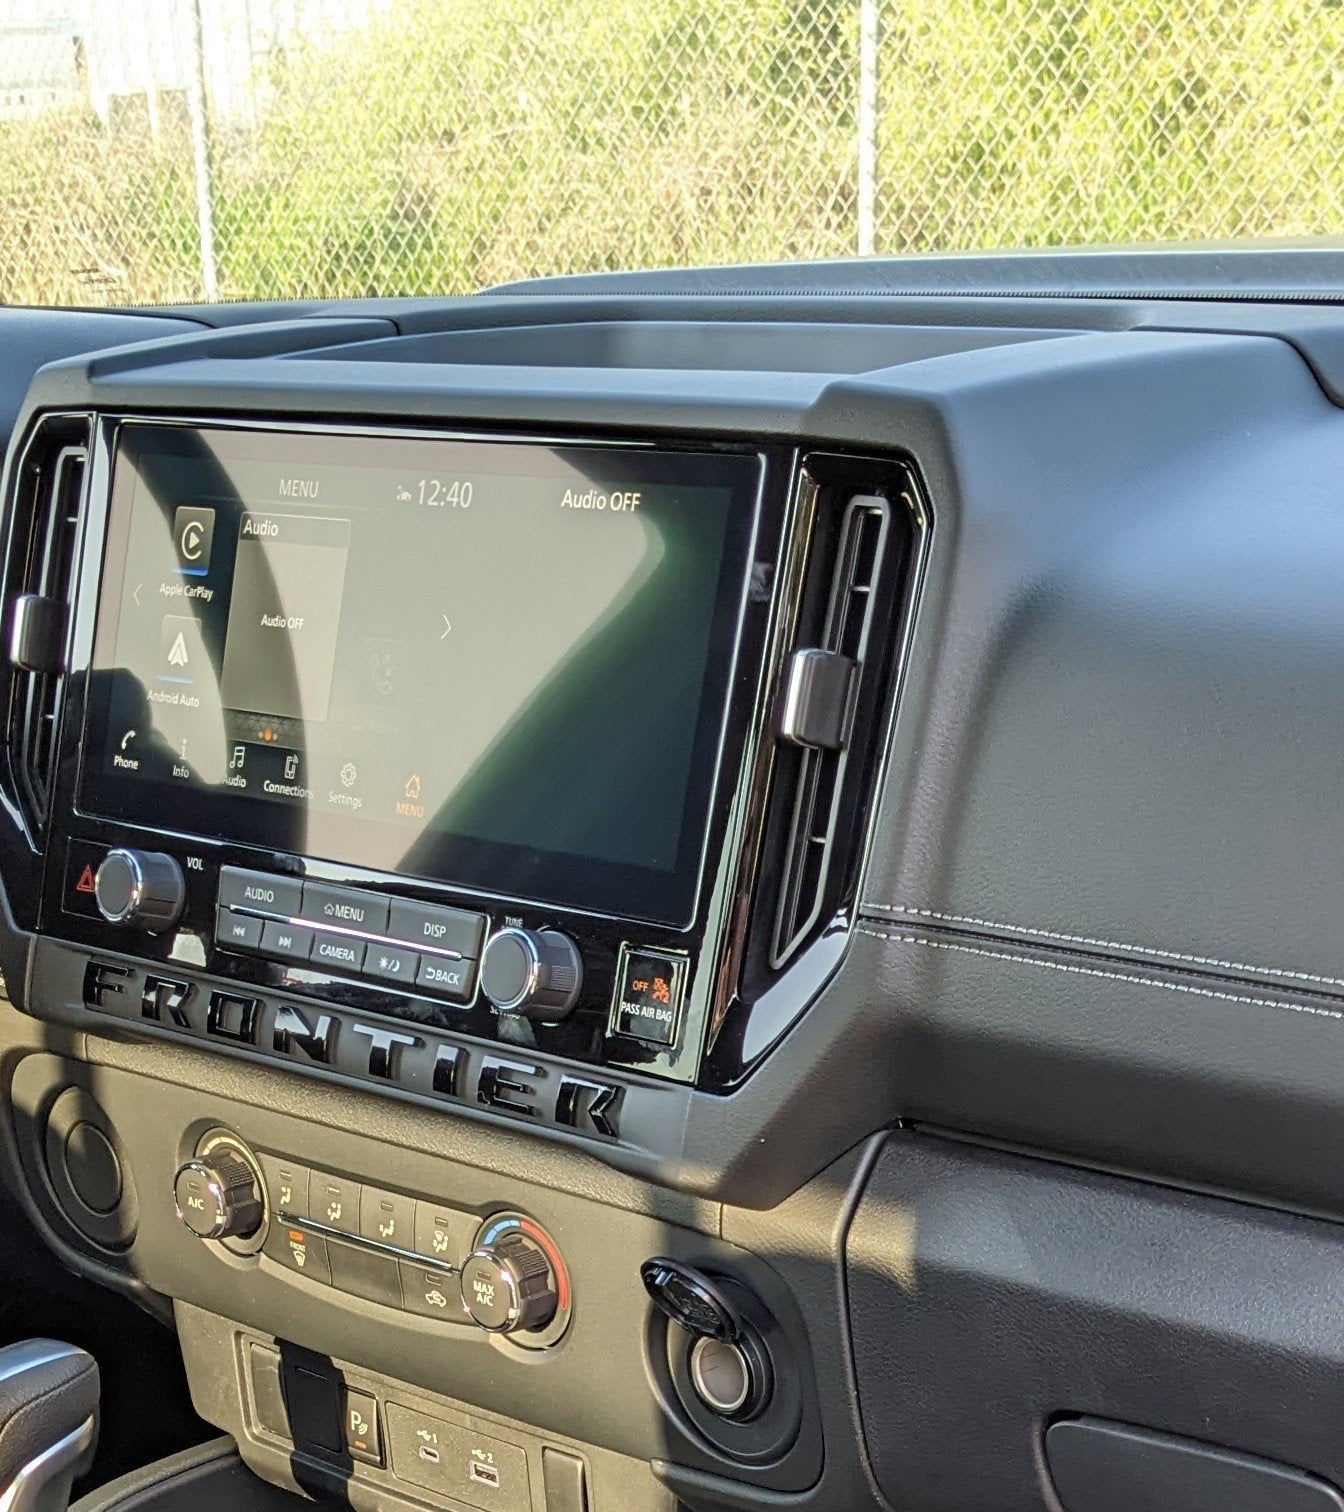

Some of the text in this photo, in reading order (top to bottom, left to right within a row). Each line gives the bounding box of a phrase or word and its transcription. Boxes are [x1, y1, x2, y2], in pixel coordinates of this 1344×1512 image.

[279, 479, 319, 497] MENU
[417, 480, 473, 508] 12:40
[561, 489, 641, 512] Audio OFF
[243, 518, 279, 537] Audio
[159, 582, 214, 602] Apple CarPlay
[260, 614, 305, 630] Audio OFF
[147, 689, 200, 708] Android Auto
[114, 755, 139, 770] Phone
[173, 765, 189, 779] Info
[264, 780, 314, 800] Connections
[328, 791, 362, 809] Settings
[396, 803, 424, 818] MENU
[187, 856, 204, 871] VOL
[244, 886, 274, 903] AUDIO
[335, 905, 364, 922] MENU
[423, 922, 447, 938] DISP
[319, 943, 355, 962] CAMERA
[435, 969, 460, 985] BACK
[632, 980, 649, 992] OFF
[621, 1001, 672, 1022] PASS AIR BAG
[82, 960, 623, 1140] FRONTIER
[188, 1196, 205, 1211] A/C
[473, 1280, 494, 1297] MAX
[476, 1293, 494, 1307] A/C
